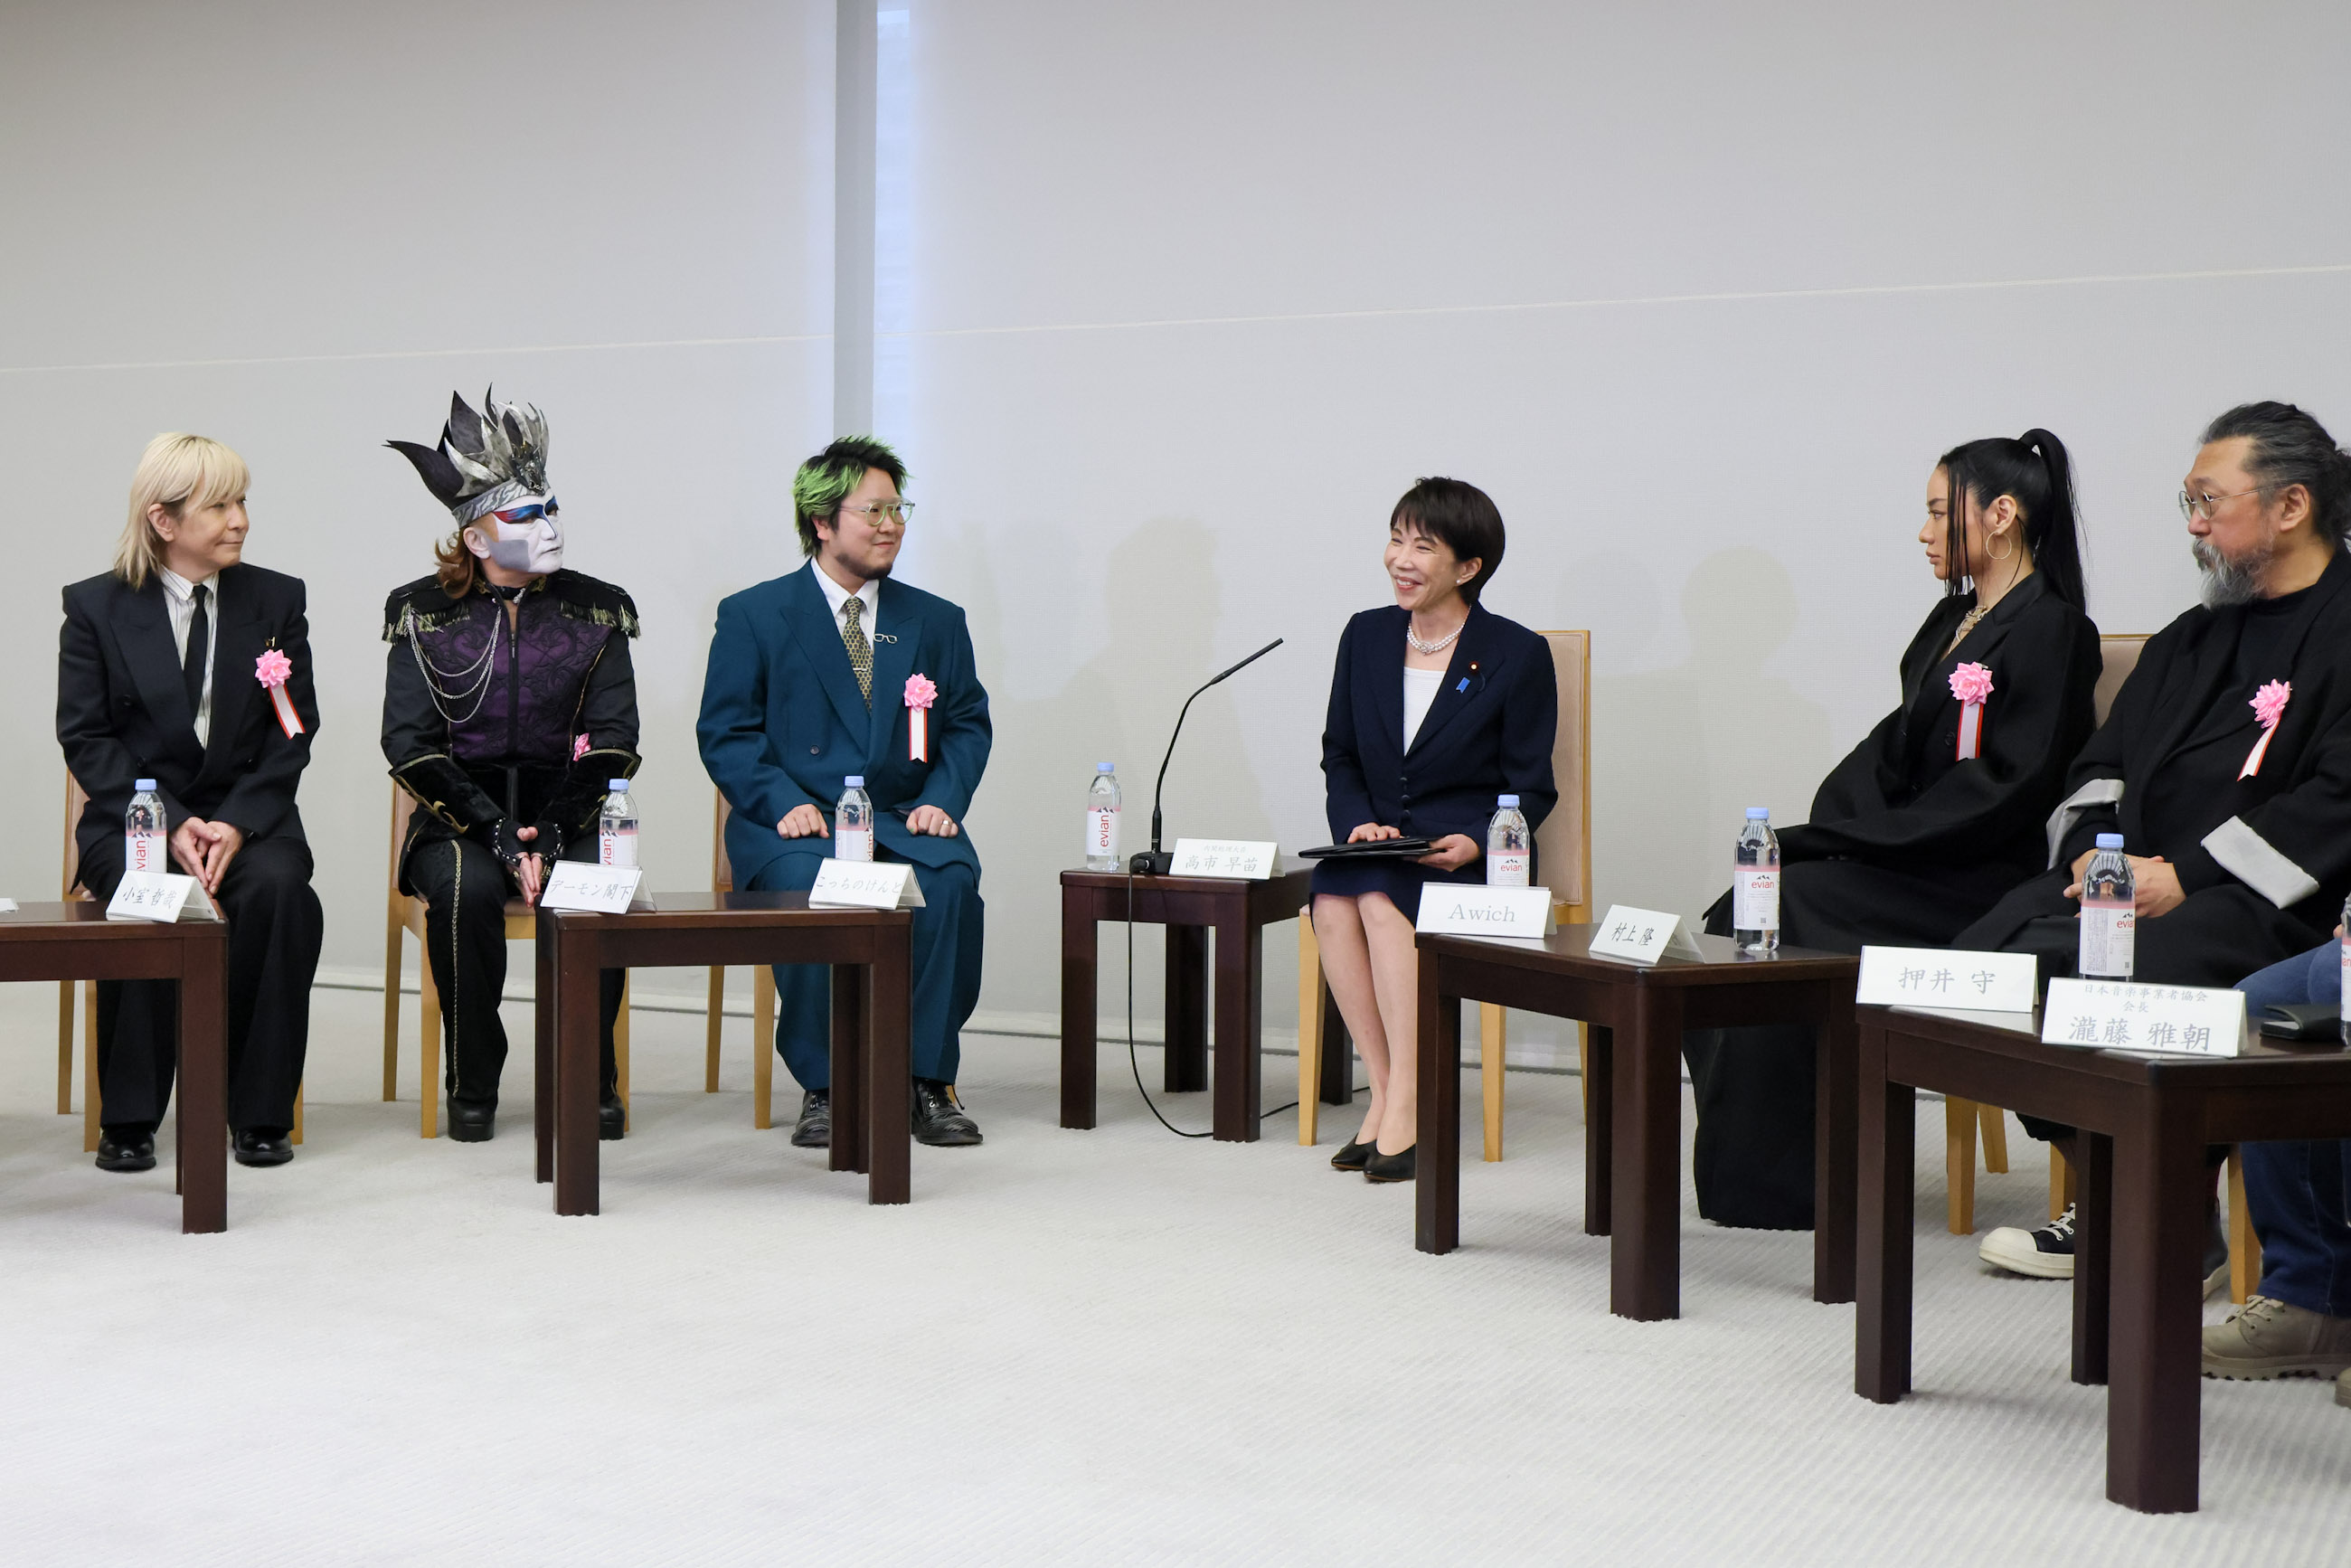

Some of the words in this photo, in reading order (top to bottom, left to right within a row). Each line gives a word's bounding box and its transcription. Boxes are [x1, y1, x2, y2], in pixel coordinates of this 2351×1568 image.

[1099, 815, 1109, 847] evian
[135, 840, 146, 871] vian
[602, 838, 612, 865] vian
[1185, 855, 1219, 871] 高市
[1224, 856, 1258, 873] 早苗
[1500, 864, 1523, 872] evian
[123, 886, 150, 903] 小室
[550, 880, 633, 901] デーモン閣下
[1751, 881, 1775, 889] evian
[1448, 903, 1515, 922] Awich
[1610, 921, 1635, 942] 村上
[1638, 926, 1655, 946] 隆
[2116, 919, 2135, 929] evia
[1898, 967, 1955, 993] 押井
[1971, 969, 1997, 995] 守
[2084, 984, 2208, 1002] 日本音楽事業者協会
[2123, 1001, 2149, 1013] 会長
[2068, 1016, 2132, 1044] 瀧藤
[2147, 1022, 2211, 1052] 雅朝
